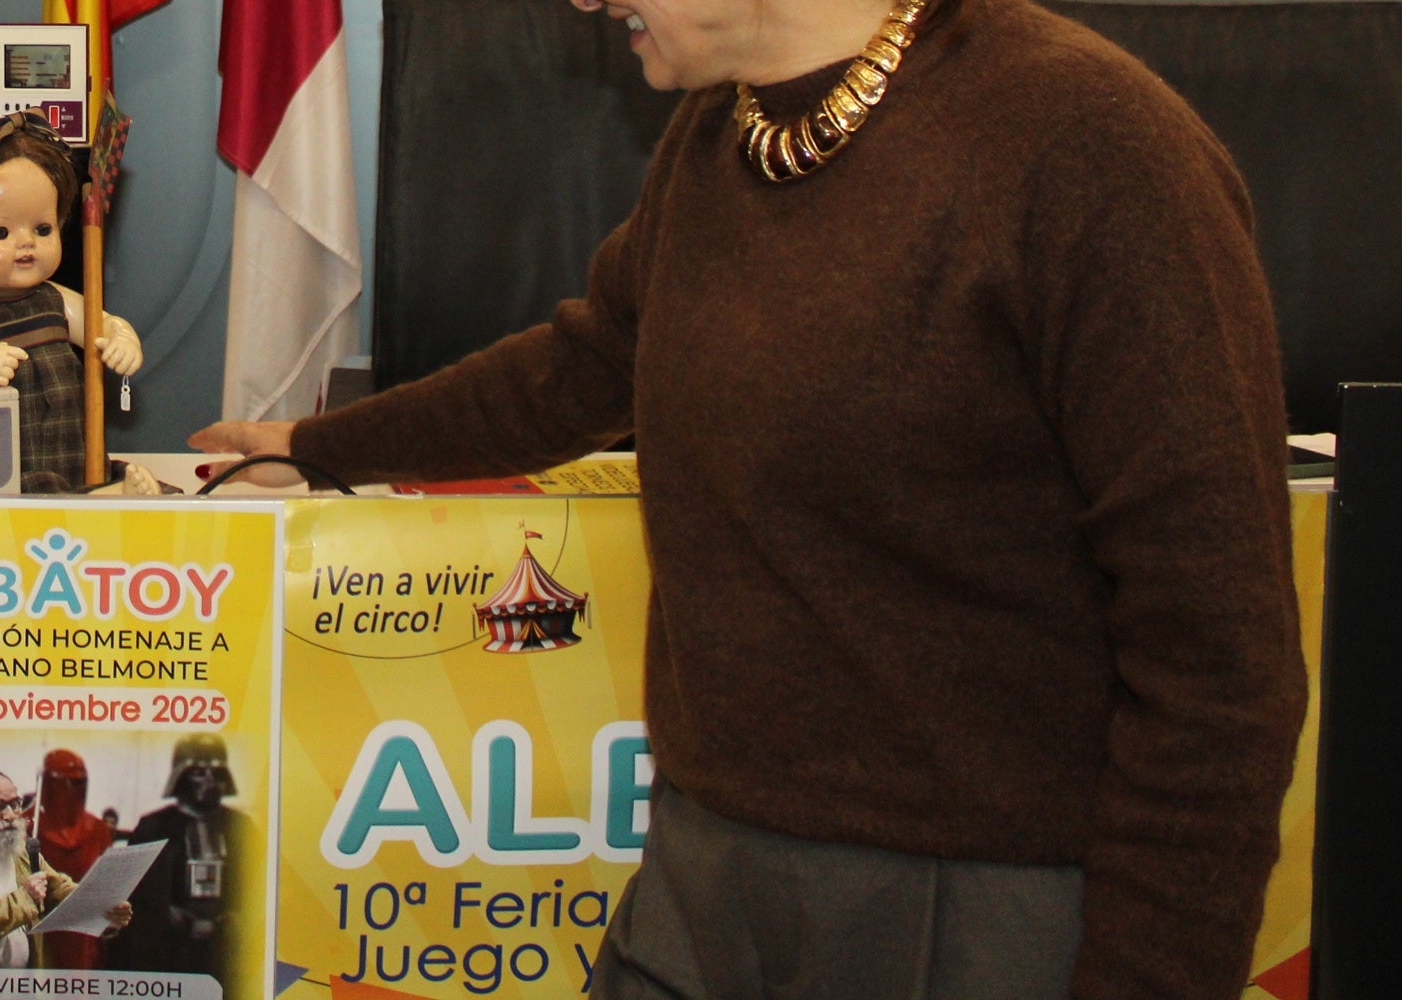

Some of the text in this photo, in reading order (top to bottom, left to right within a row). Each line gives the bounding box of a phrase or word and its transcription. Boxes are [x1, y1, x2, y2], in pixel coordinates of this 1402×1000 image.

[312, 565, 495, 600] ¡Ven a vivir
[315, 602, 443, 635] el circo!
[53, 629, 202, 652] HOMENAJE
[212, 632, 229, 652] A
[62, 660, 208, 681] BELMONTE
[152, 695, 226, 724] 2025
[452, 878, 608, 929] Feria
[340, 934, 549, 994] Juego
[108, 979, 182, 998] 12:00H
